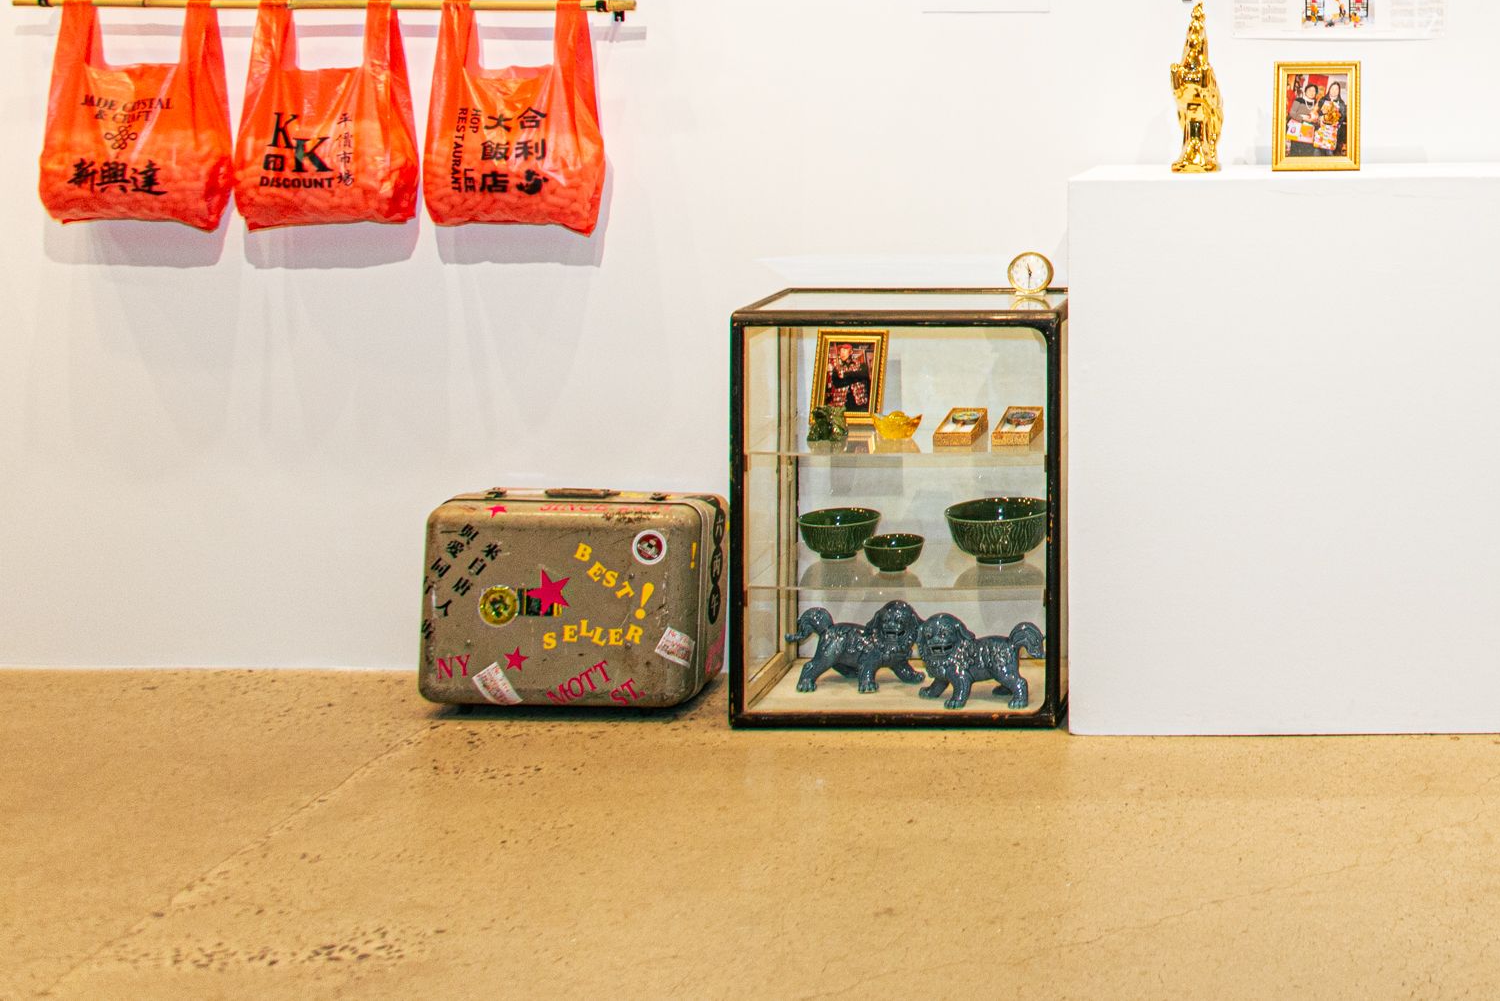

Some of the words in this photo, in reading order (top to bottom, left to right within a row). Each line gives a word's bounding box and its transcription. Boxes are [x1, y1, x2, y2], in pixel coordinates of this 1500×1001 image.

[469, 108, 481, 133] HOP
[451, 108, 468, 193] RESTAURANT
[67, 158, 168, 195] 新興達
[260, 176, 334, 189] DISCOUNT
[464, 168, 476, 193] LEE
[543, 619, 644, 650] SELLER
[436, 654, 471, 680] NY
[546, 660, 614, 705] MOTT
[610, 678, 646, 705] ST.
